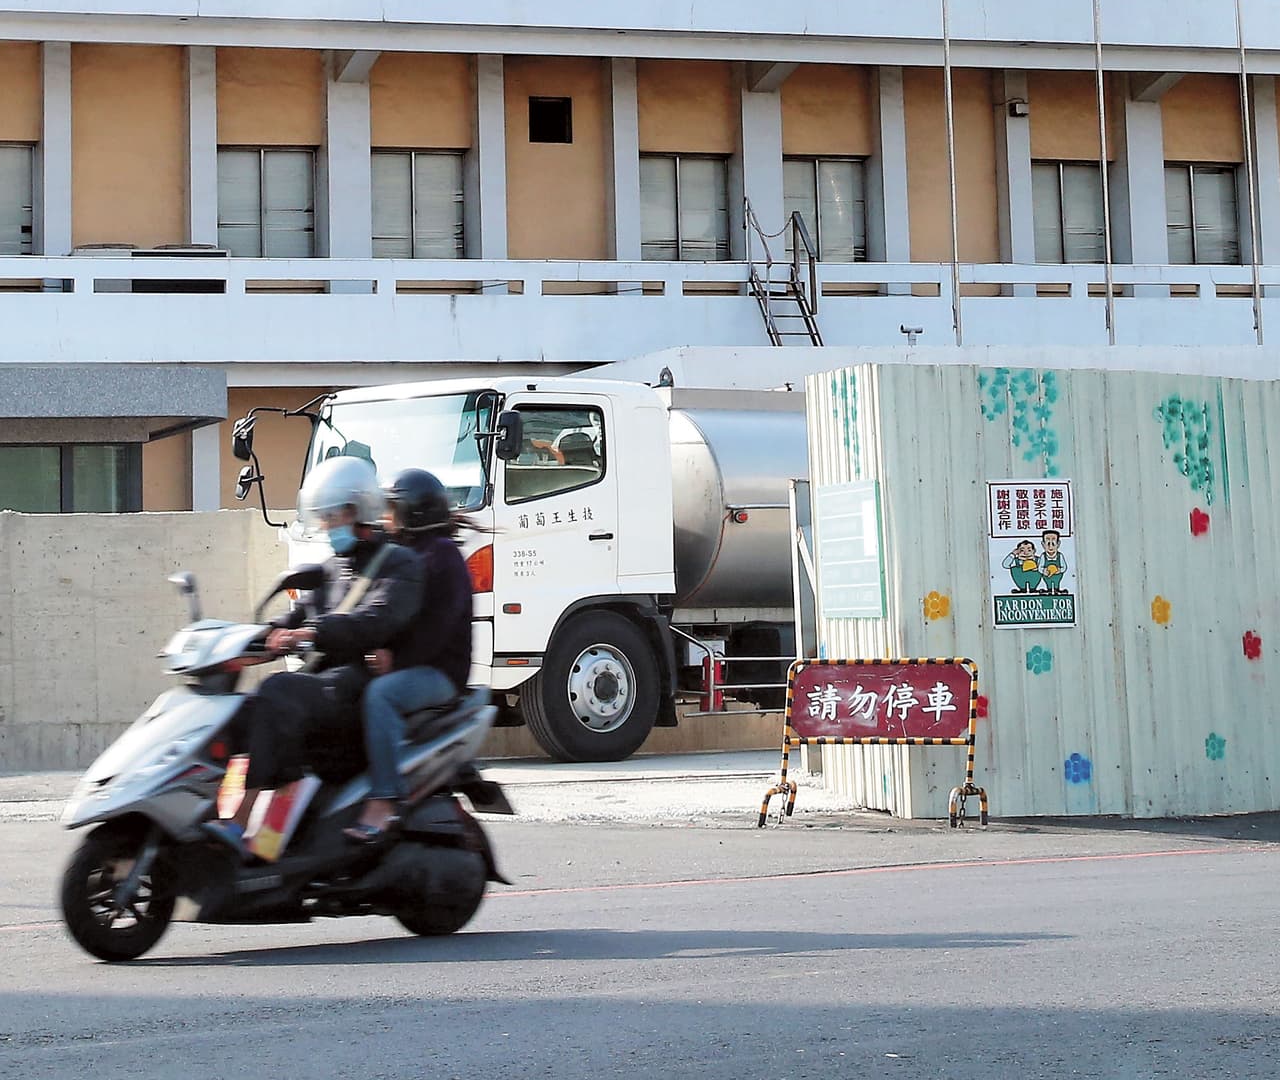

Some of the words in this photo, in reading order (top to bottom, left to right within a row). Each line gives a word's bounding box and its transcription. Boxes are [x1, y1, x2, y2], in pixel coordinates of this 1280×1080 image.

[518, 506, 594, 529] 葡萄王生技
[996, 489, 1011, 530] 謝謝合作
[1016, 489, 1030, 530] 敬請原諒
[1033, 489, 1047, 530] 諸多不便
[1051, 489, 1064, 530] 施工期間
[996, 599, 1043, 610] PARDON
[1053, 598, 1073, 610] FOR
[997, 609, 1073, 622] INCONVENIENCE
[806, 681, 958, 722] 請勿停車
